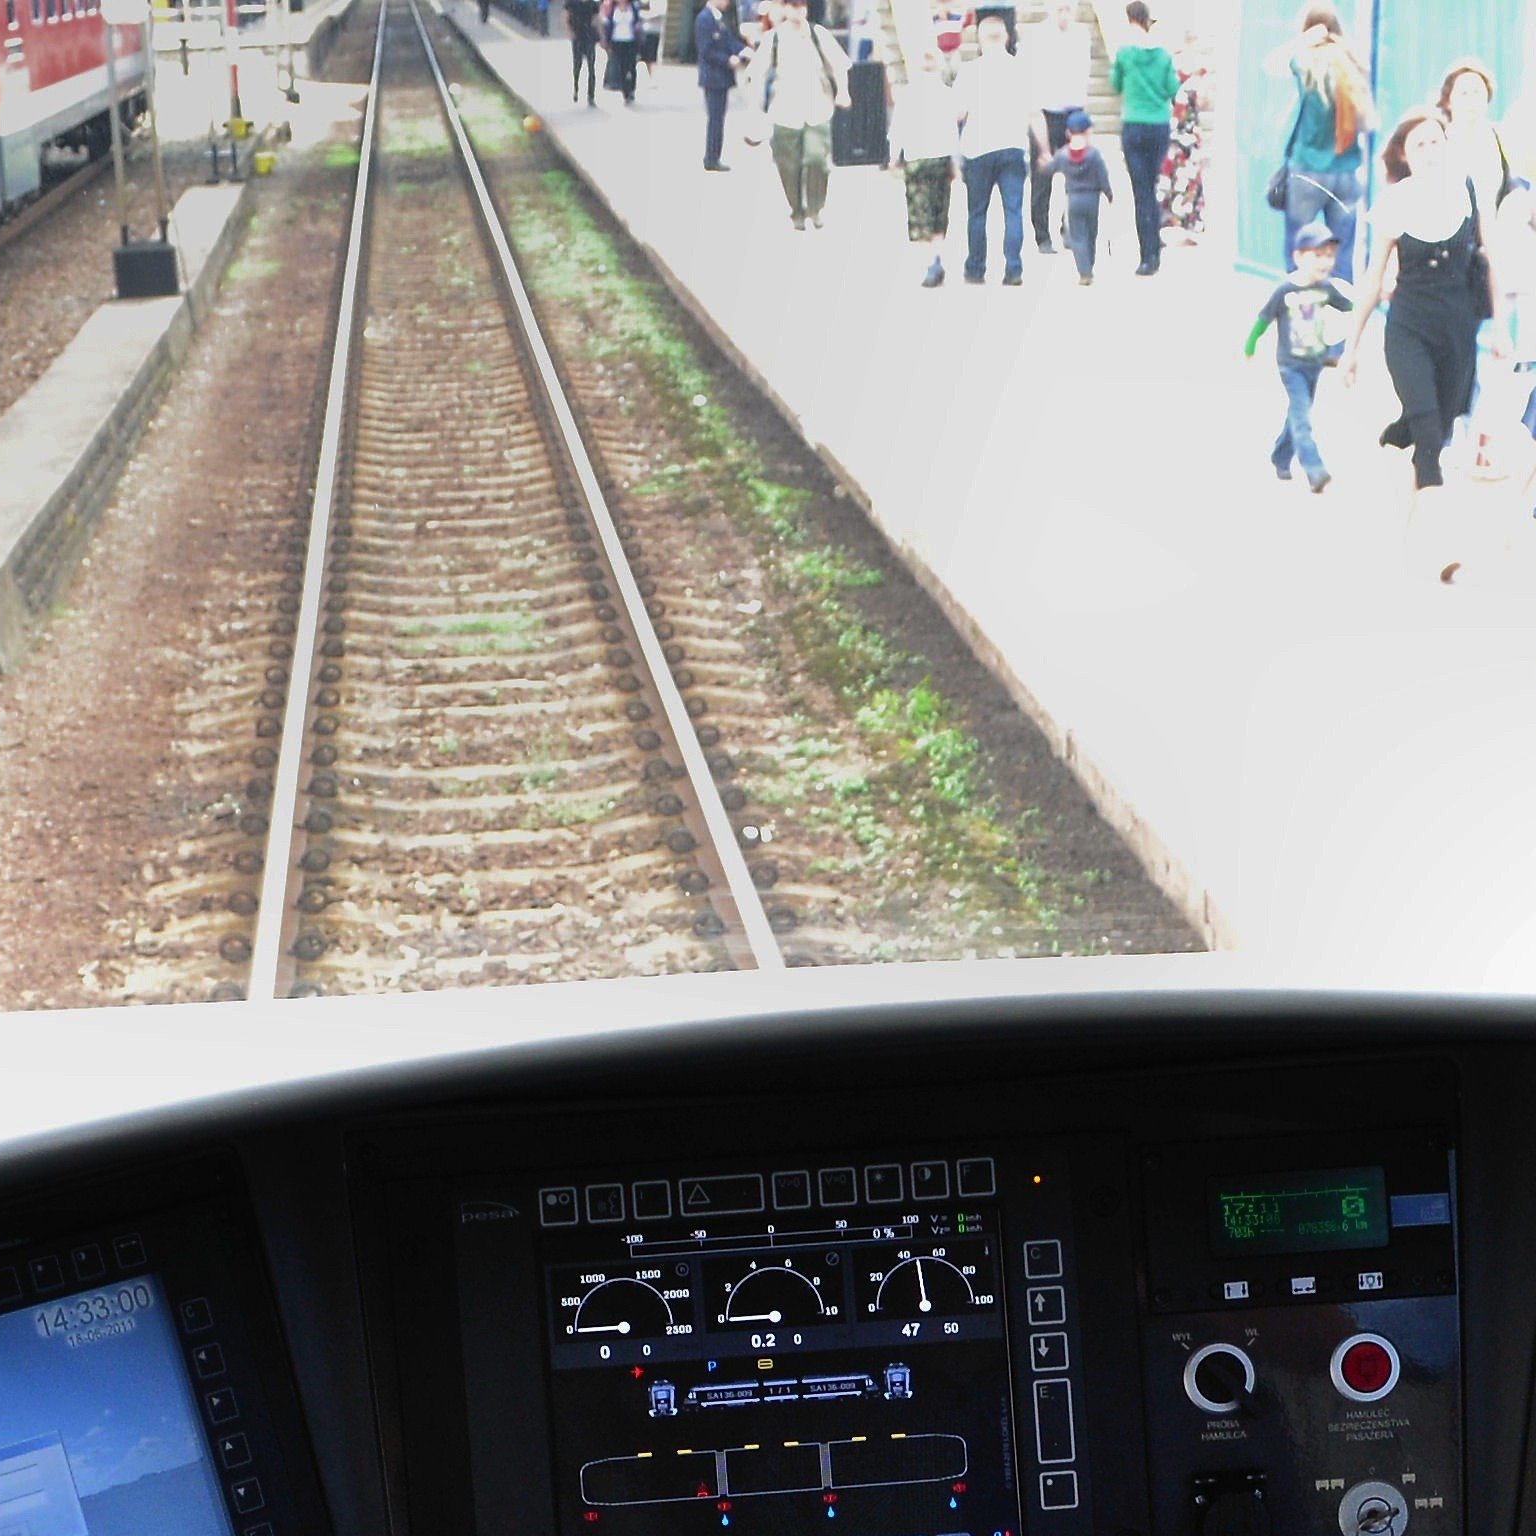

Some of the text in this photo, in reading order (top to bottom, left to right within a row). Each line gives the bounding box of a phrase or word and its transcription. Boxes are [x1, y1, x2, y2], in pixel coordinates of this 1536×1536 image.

[835, 1219, 847, 1229] 50
[902, 1214, 920, 1225] 100
[897, 1250, 911, 1260] 40
[931, 1247, 946, 1258] 60
[580, 1274, 606, 1284] 1000
[635, 1269, 661, 1280] 1500
[869, 1272, 883, 1282] 20
[663, 1288, 690, 1300] 2000
[561, 1296, 581, 1307] 500
[974, 1295, 994, 1306] 100
[36, 1283, 152, 1337] 14:33:00
[825, 1305, 838, 1316] 10
[666, 1324, 693, 1335] 2500
[901, 1323, 921, 1337] 47
[943, 1322, 959, 1335] 50
[751, 1334, 776, 1349] 0.2
